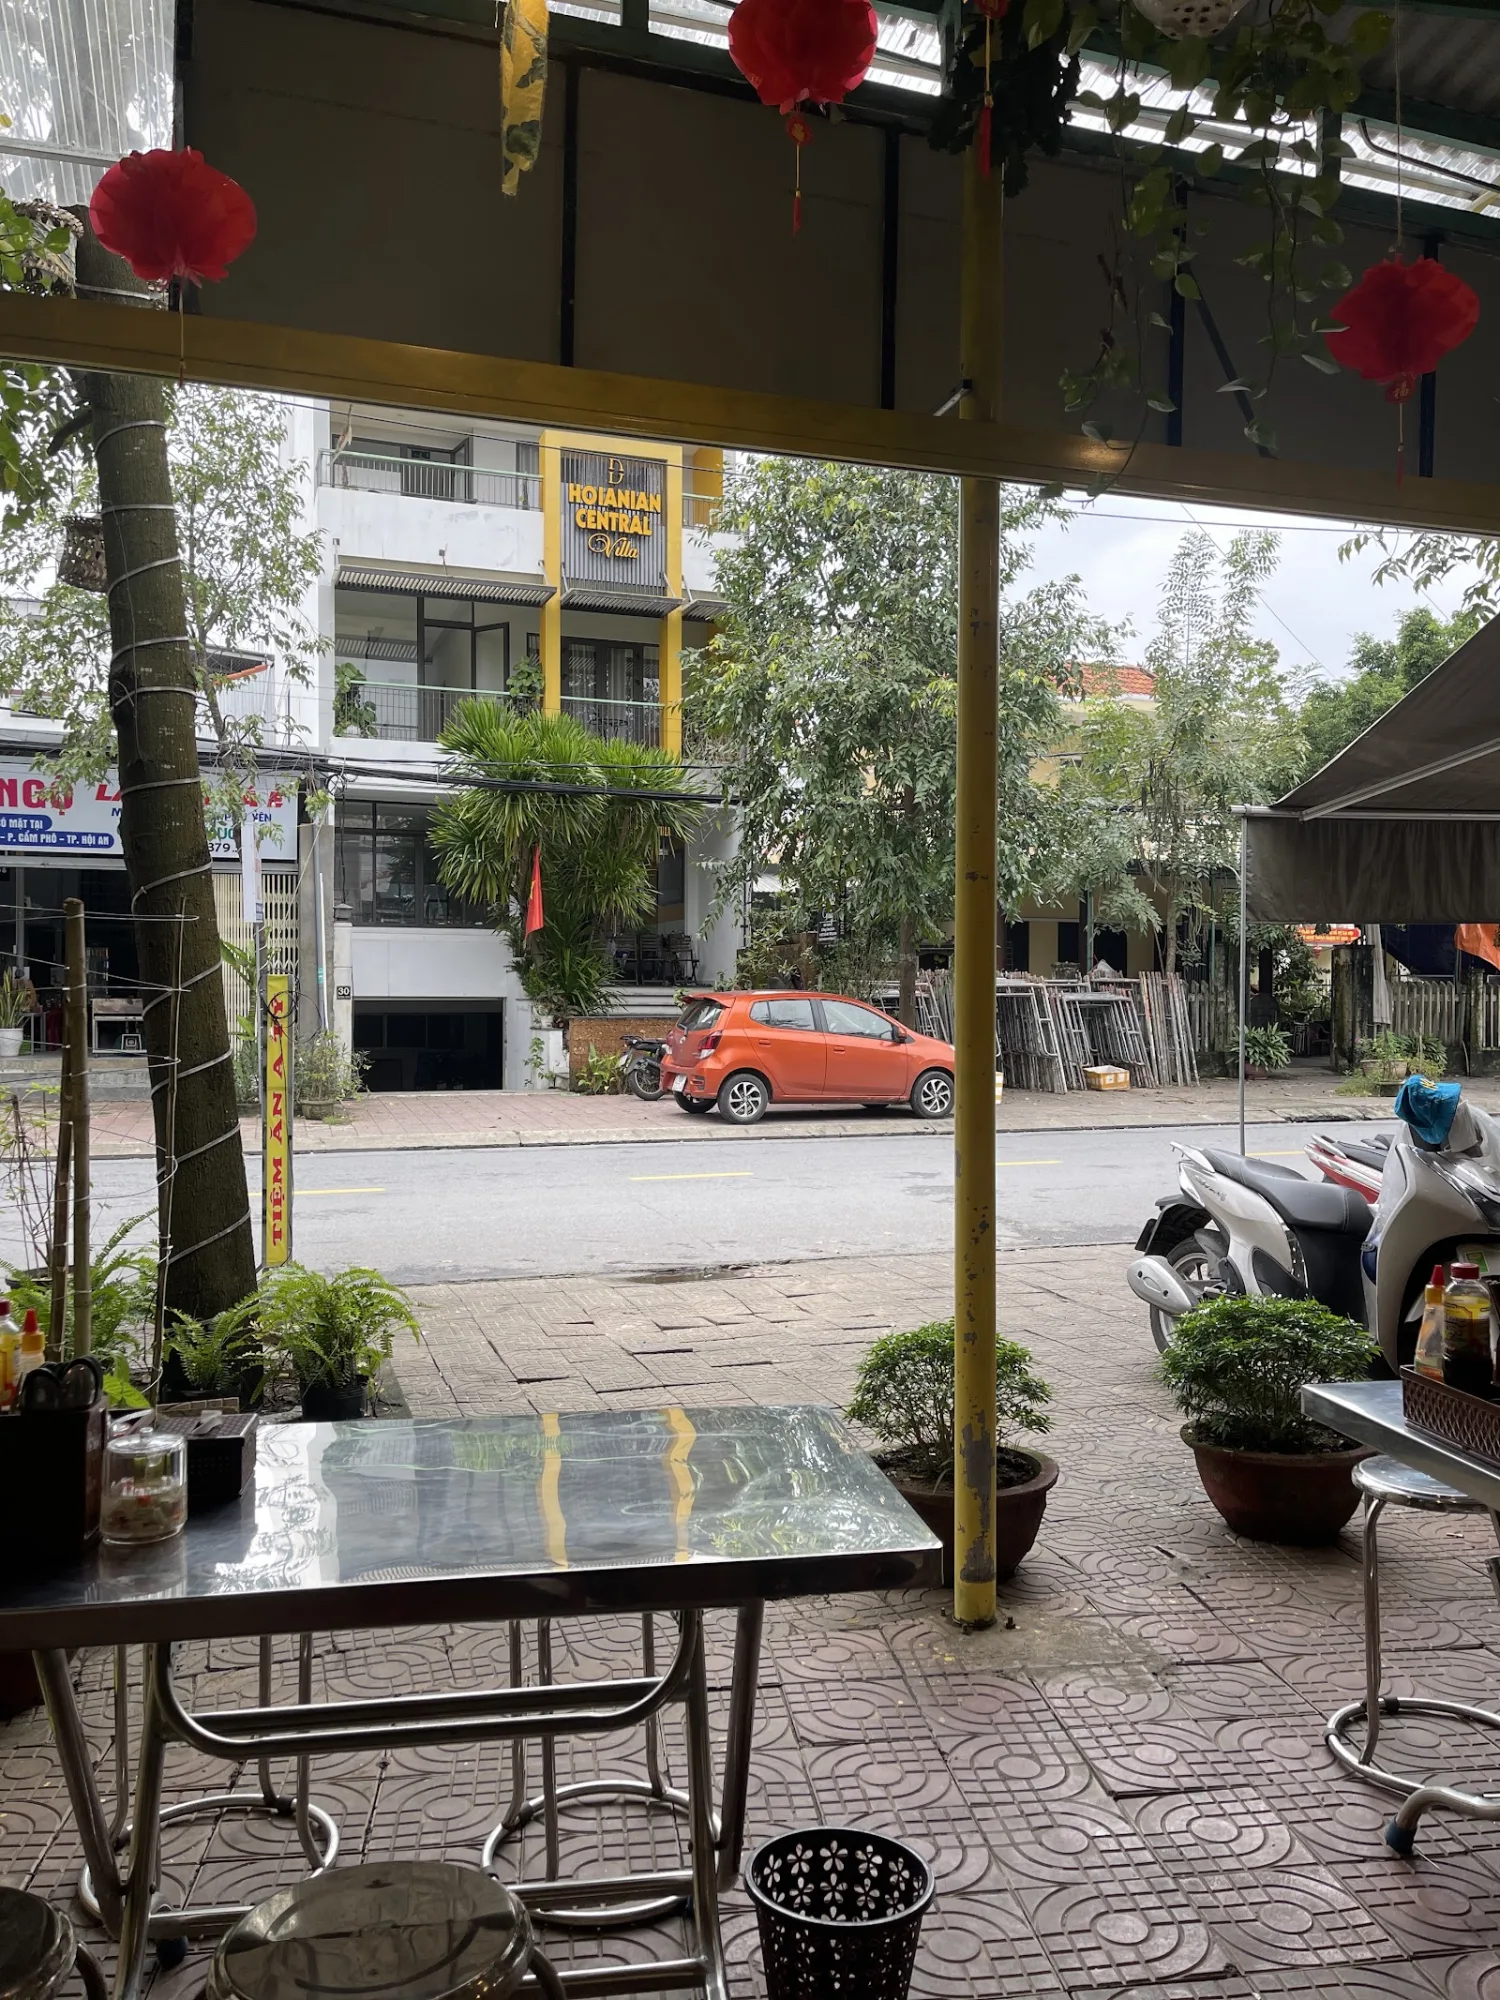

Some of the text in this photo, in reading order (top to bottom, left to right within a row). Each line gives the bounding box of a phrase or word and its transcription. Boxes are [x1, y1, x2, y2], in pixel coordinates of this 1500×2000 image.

[568, 482, 662, 514] HOIANIAN
[575, 508, 653, 536] CENTRAL
[588, 532, 640, 559] Villa
[66, 834, 80, 844] TP.
[81, 834, 96, 846] HỘI
[98, 836, 109, 845] AN
[338, 986, 350, 996] 30
[272, 1053, 284, 1079] A
[270, 1092, 284, 1145] ĂN
[270, 1157, 285, 1247] TIỆM
